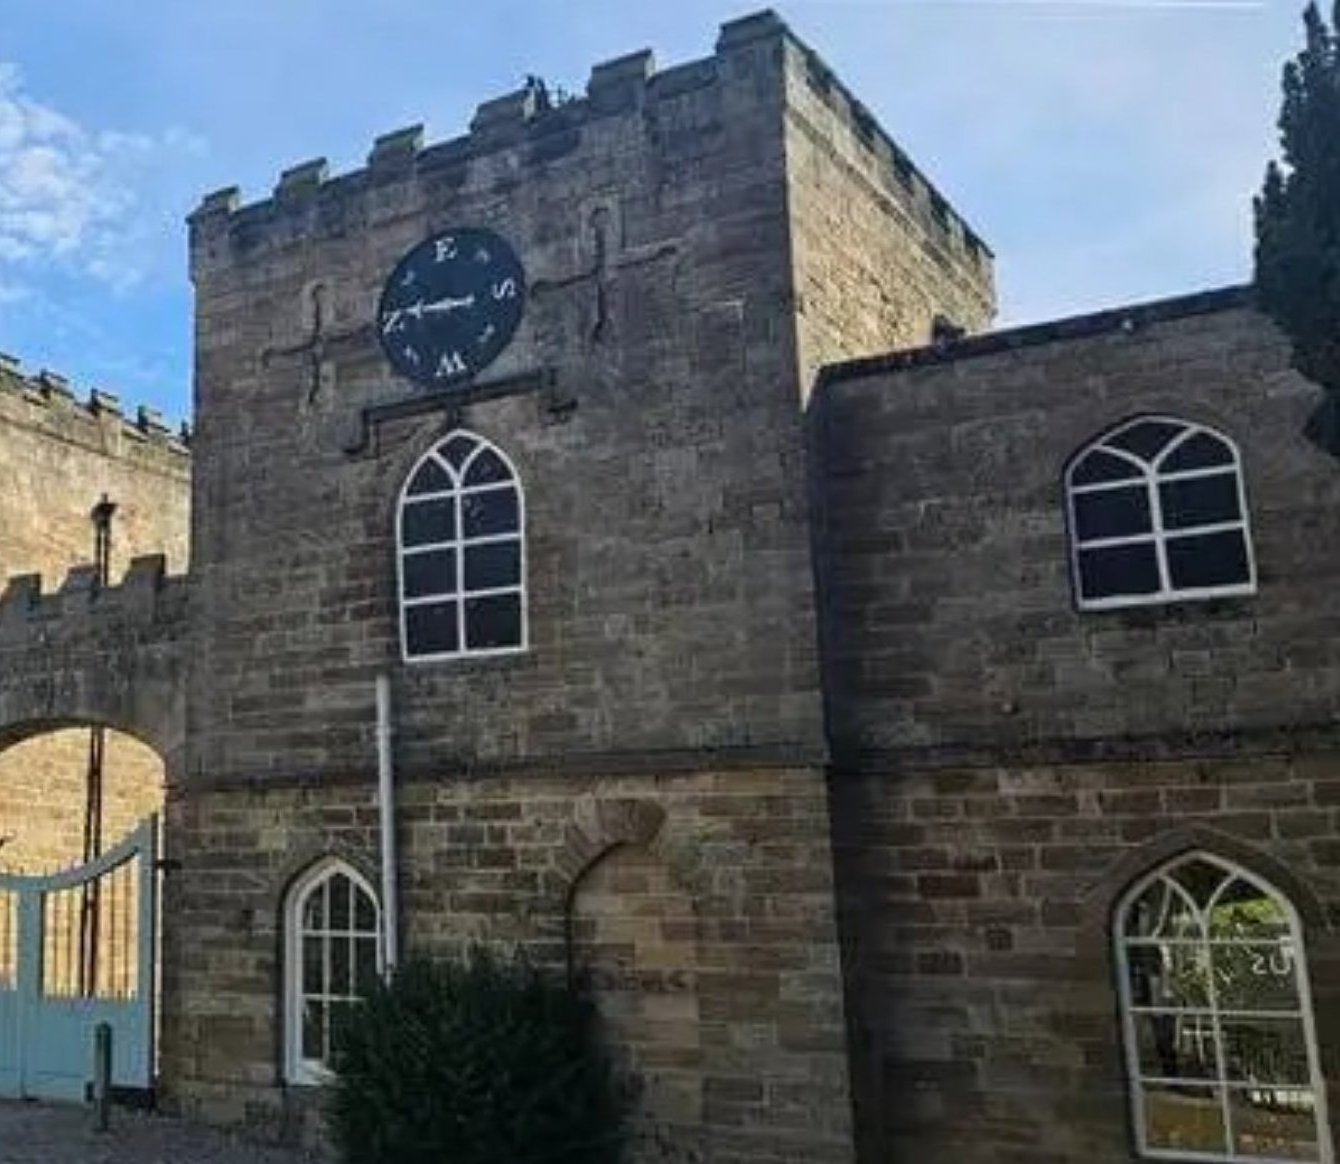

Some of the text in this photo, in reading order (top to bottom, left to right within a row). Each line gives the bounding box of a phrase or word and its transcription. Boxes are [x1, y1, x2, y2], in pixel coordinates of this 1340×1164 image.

[435, 237, 457, 262] E
[492, 278, 515, 299] S
[382, 310, 404, 334] N
[436, 352, 466, 377] W
